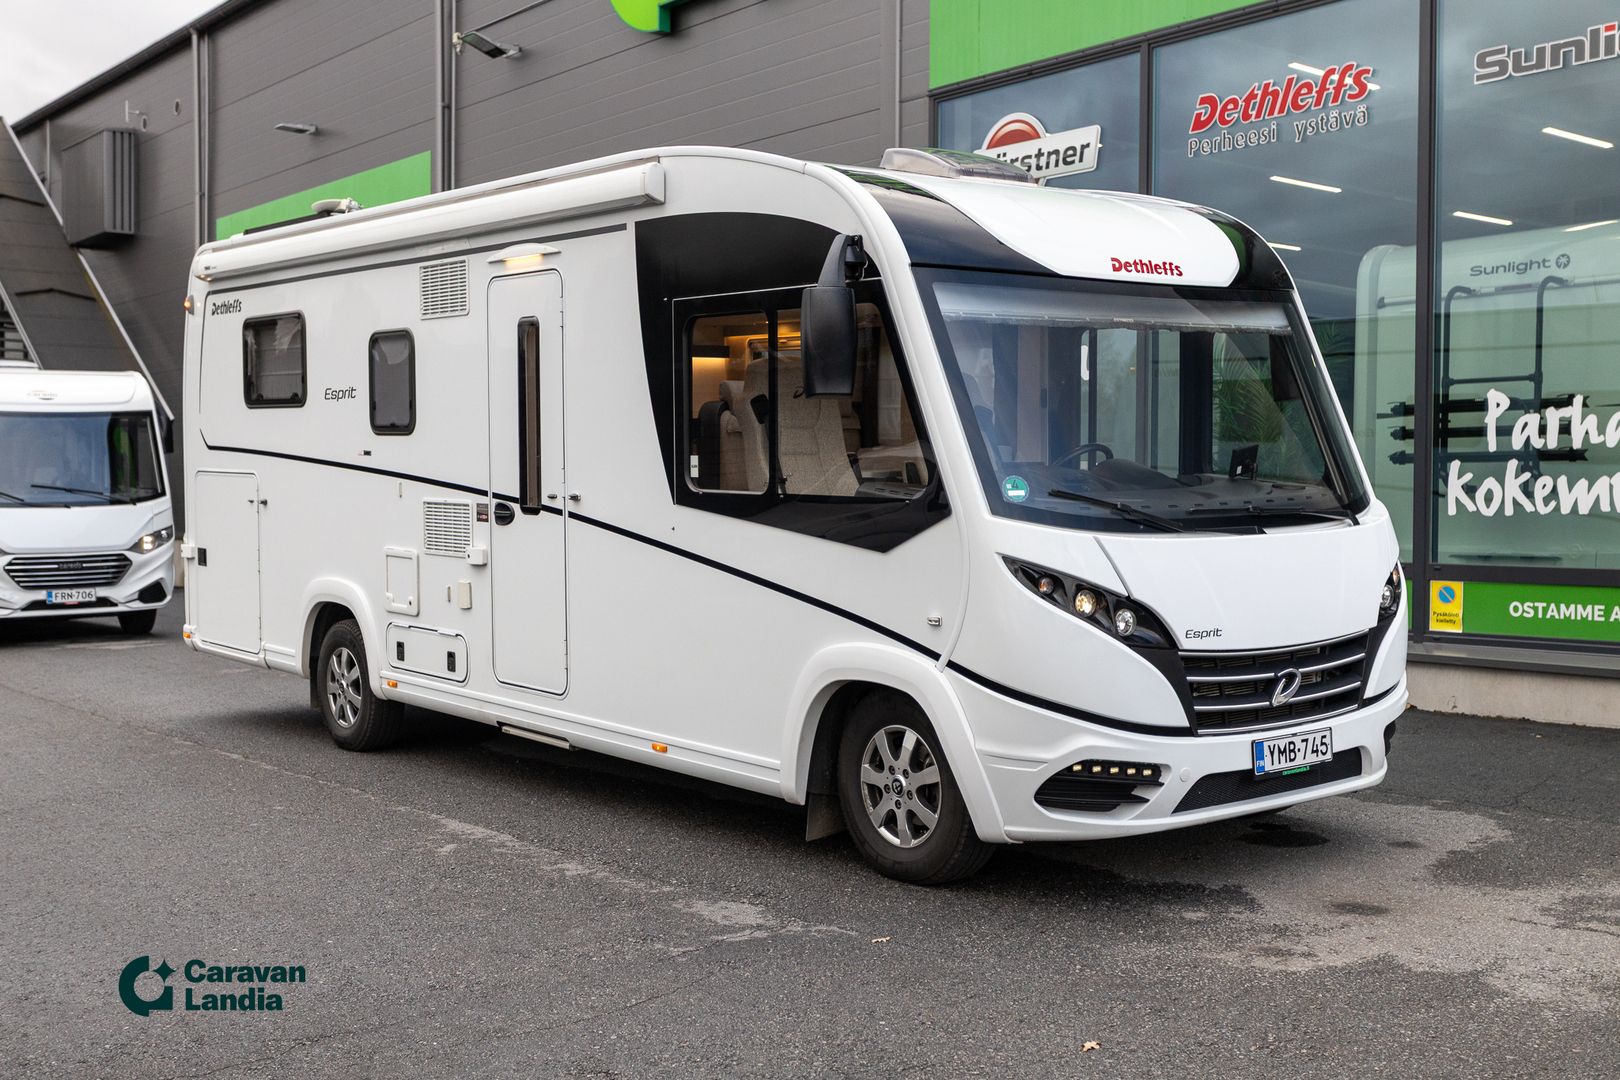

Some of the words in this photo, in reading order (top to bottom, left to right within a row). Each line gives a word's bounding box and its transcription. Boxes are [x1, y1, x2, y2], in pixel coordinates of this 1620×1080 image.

[1474, 21, 1620, 85] Sunli
[1189, 61, 1373, 134] Dethleffs
[1188, 121, 1277, 157] Perheesi
[1294, 103, 1368, 143] ystävä
[997, 142, 1091, 173] stner
[1110, 256, 1183, 277] Dethleffs
[1469, 258, 1551, 277] Sunlight
[211, 298, 242, 316] Dethleffs
[324, 386, 357, 402] Esprit
[1447, 458, 1620, 517] kokem
[54, 591, 94, 601] FRN-706
[1509, 601, 1605, 622] OSTAMME
[1185, 628, 1223, 640] Esprit
[1267, 734, 1330, 767] YMB-745
